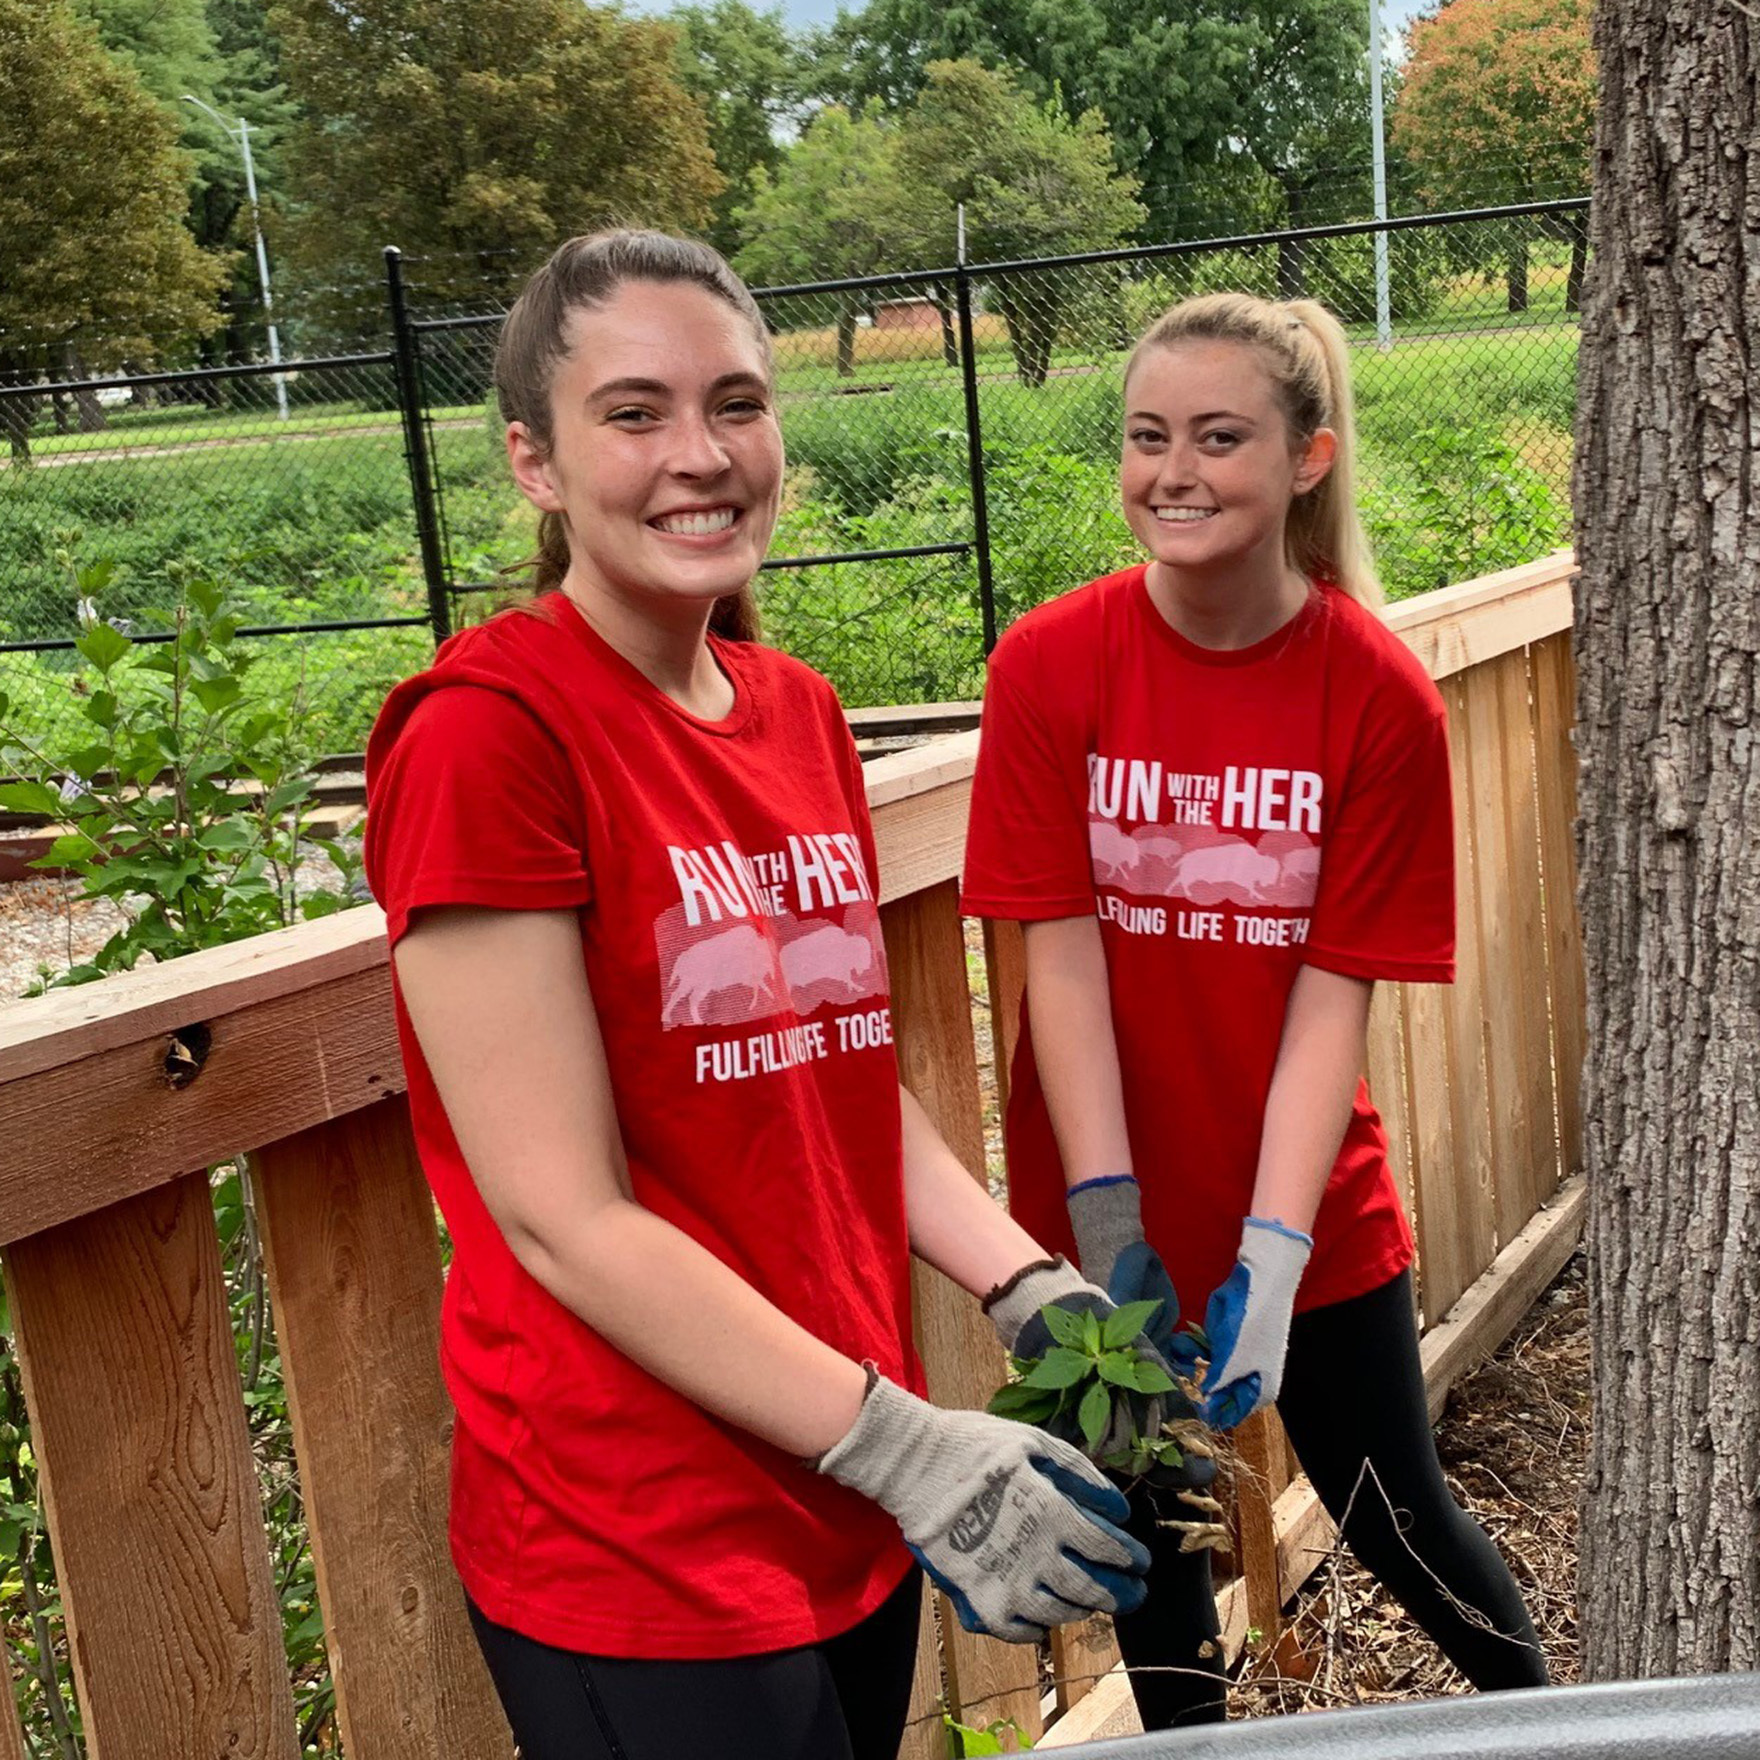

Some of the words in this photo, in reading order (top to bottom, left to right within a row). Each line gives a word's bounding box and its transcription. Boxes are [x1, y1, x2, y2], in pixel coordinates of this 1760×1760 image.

[1167, 772, 1220, 801] WITH
[1221, 766, 1324, 833] HER
[1173, 799, 1213, 826] THE
[1177, 910, 1225, 942] LIFE
